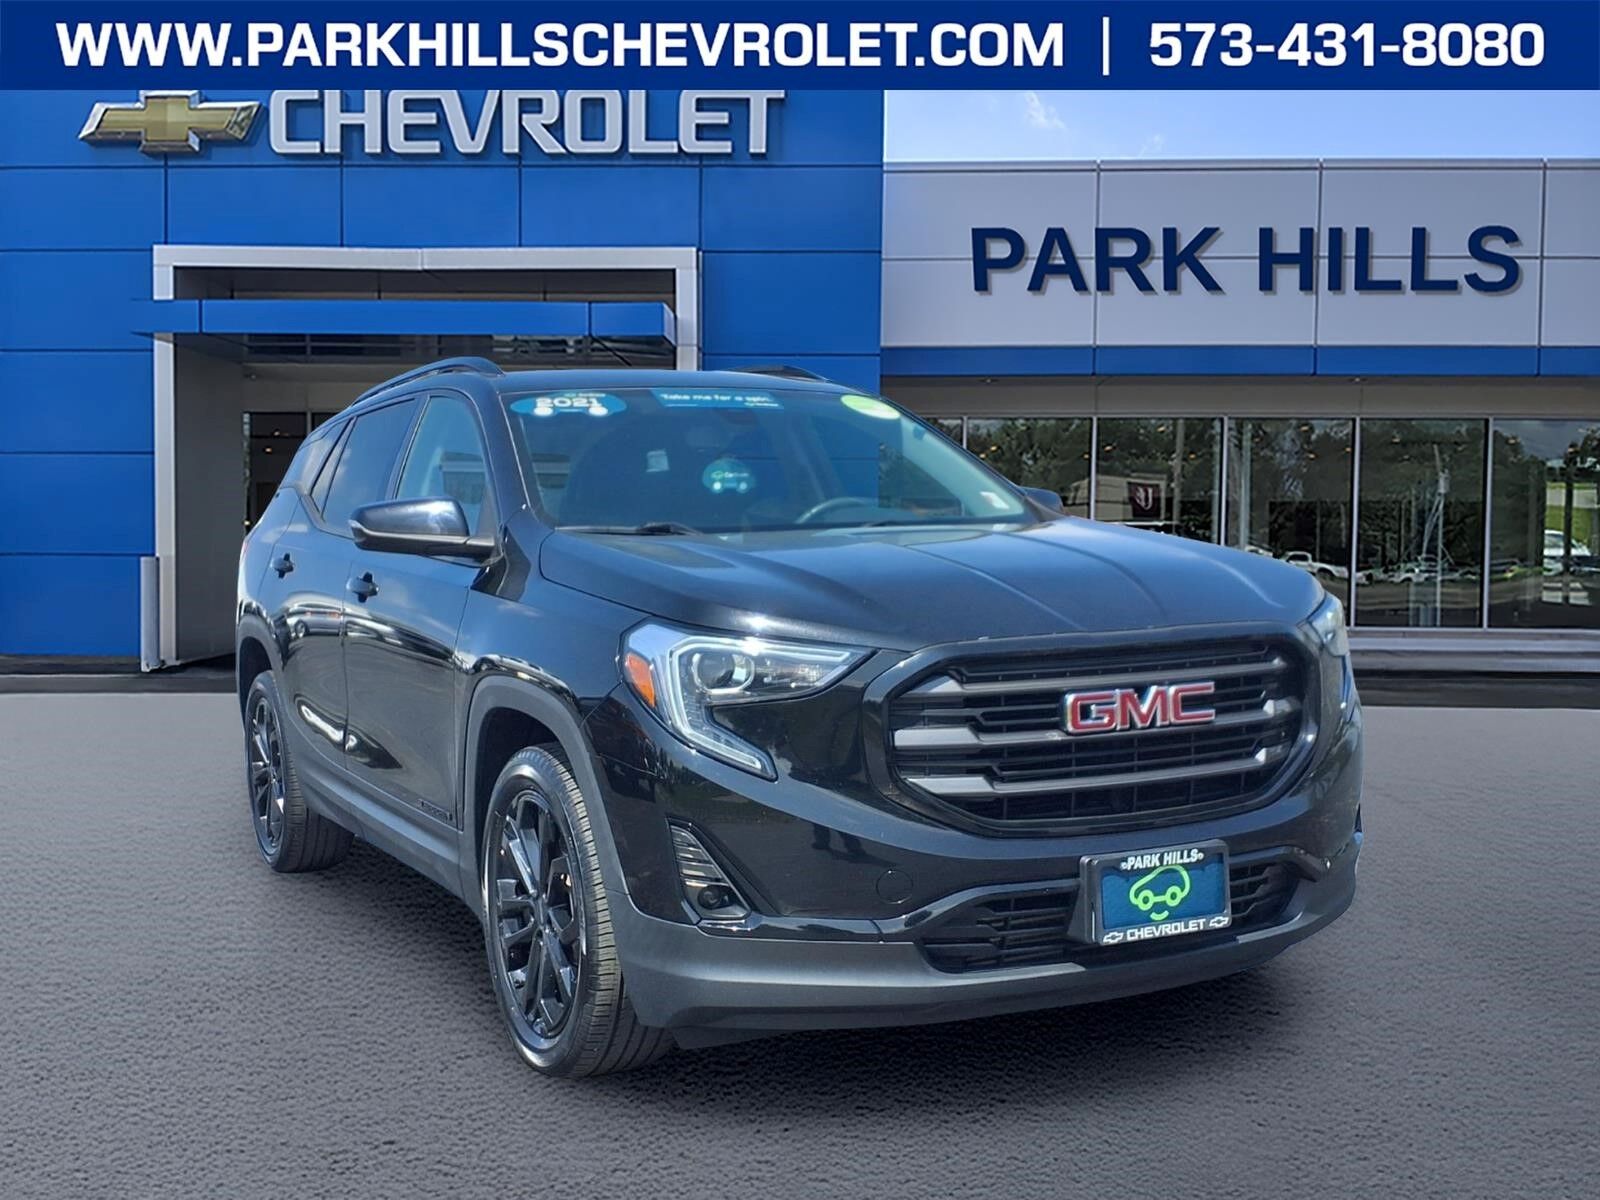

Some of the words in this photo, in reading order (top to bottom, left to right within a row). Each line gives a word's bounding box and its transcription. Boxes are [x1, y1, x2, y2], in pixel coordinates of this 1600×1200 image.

[269, 90, 786, 155] CHEVROLET
[970, 226, 1223, 294] PARK
[1258, 225, 1523, 294] HILLS
[535, 397, 602, 408] 2021
[1065, 681, 1215, 734] GMC
[1127, 853, 1160, 870] PARK
[1163, 848, 1199, 865] HILLS
[1126, 919, 1206, 940] CHEVROLET
